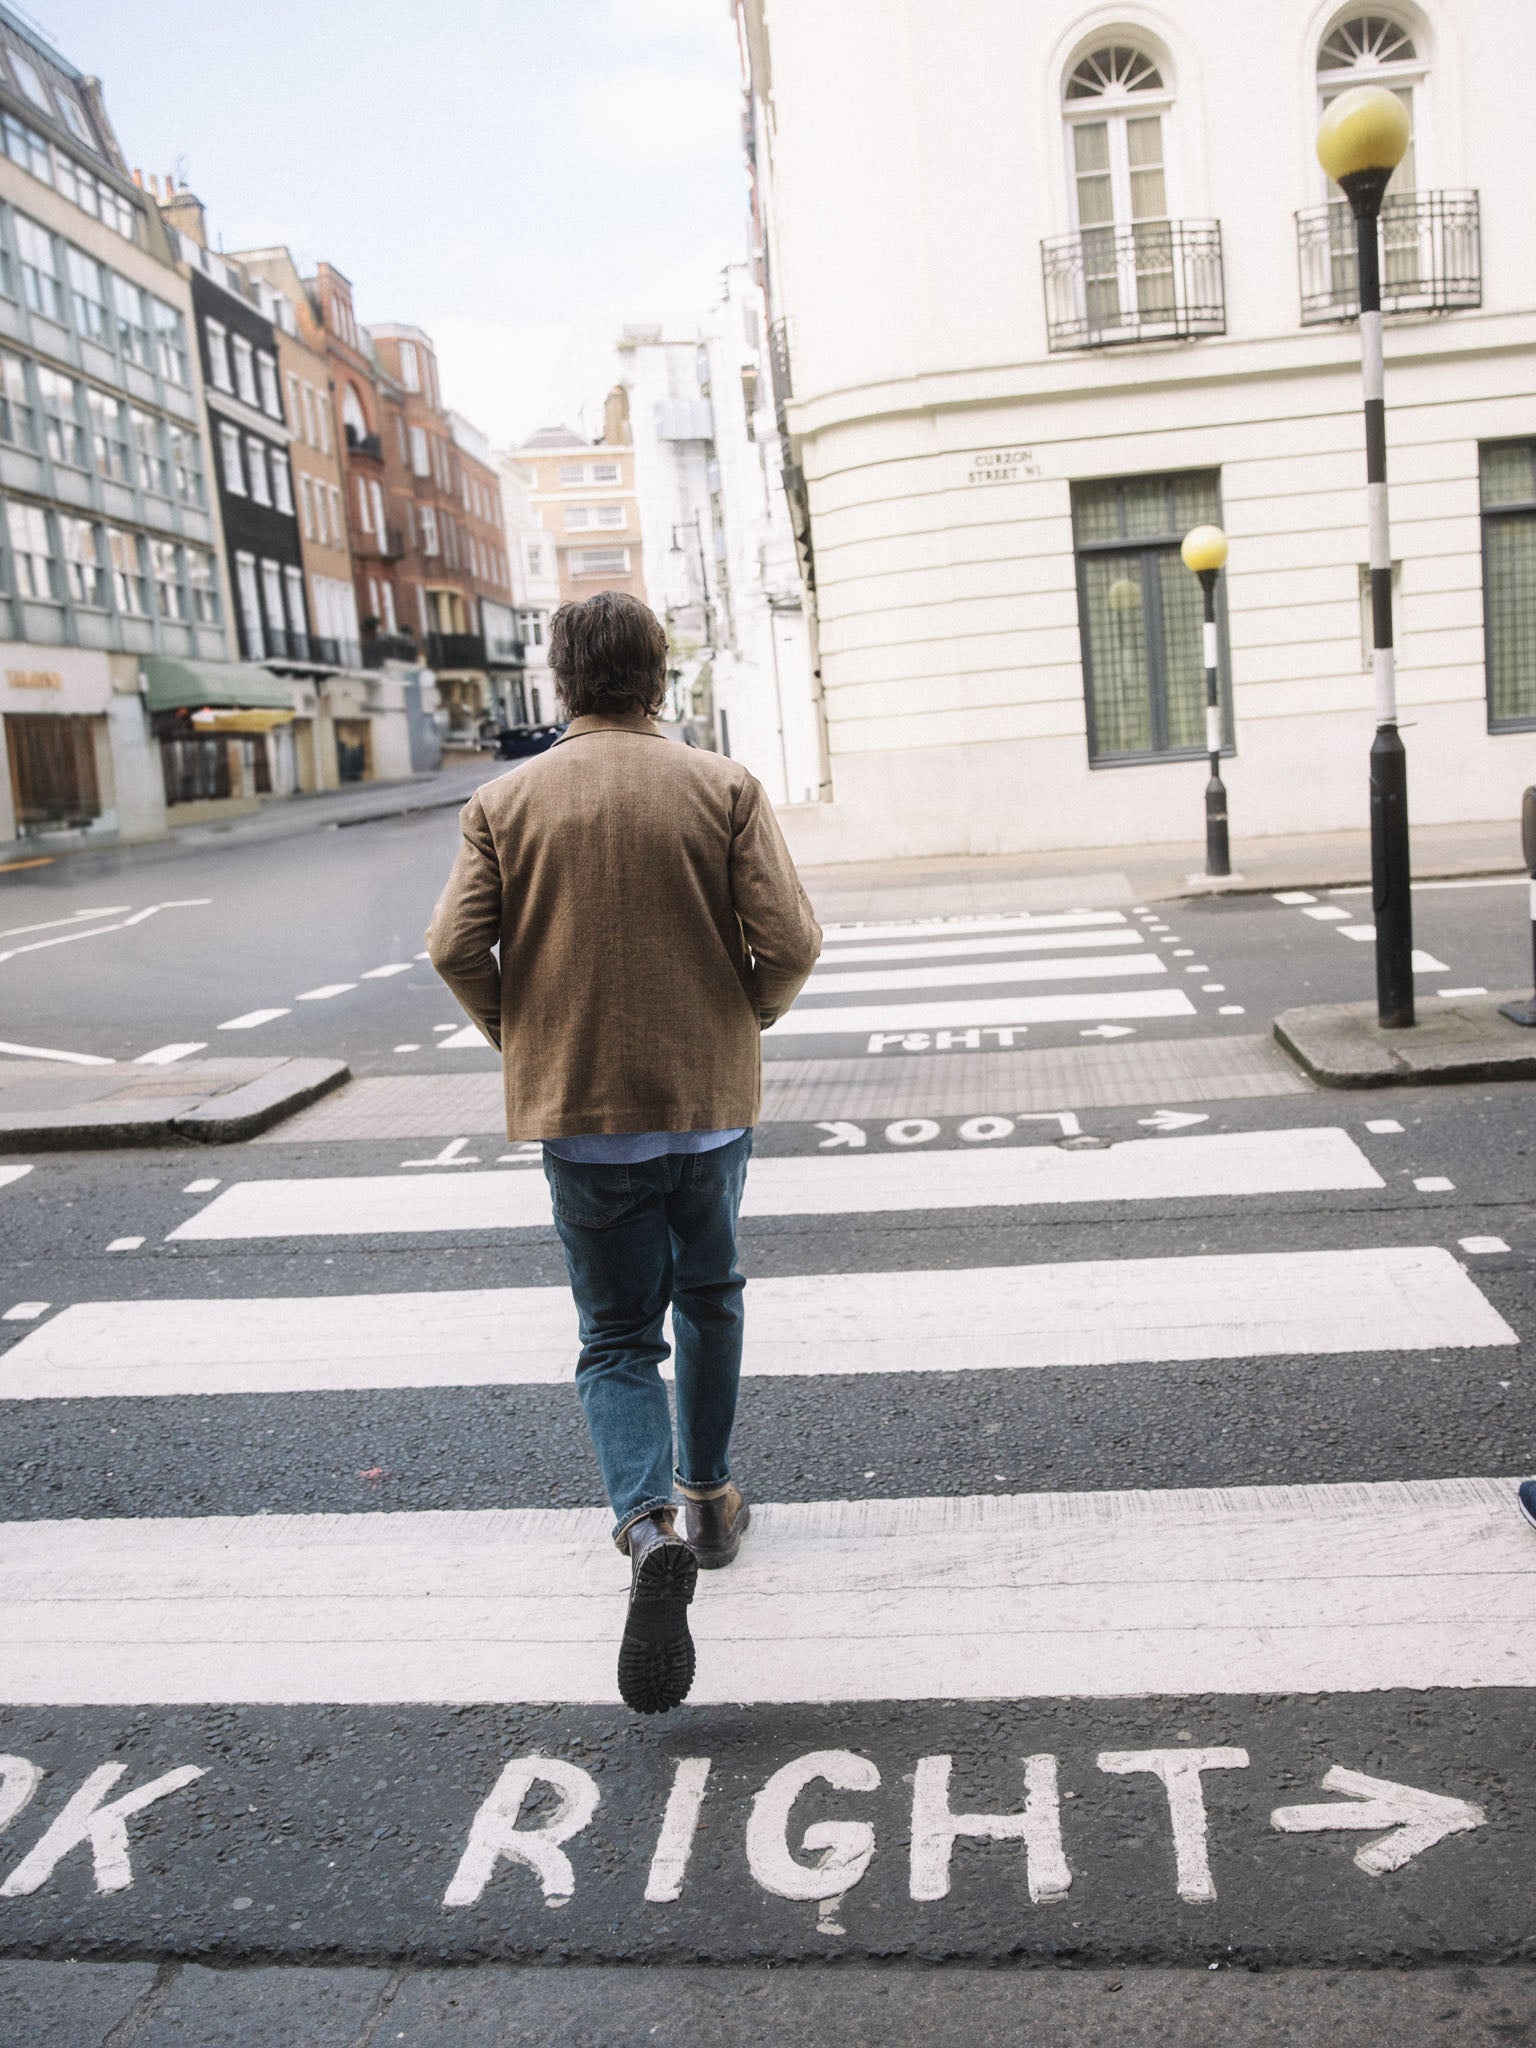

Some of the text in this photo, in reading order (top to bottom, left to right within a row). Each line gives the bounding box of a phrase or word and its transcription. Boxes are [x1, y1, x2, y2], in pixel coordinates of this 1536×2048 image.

[974, 450, 1033, 467] CURZON
[968, 467, 1018, 483] STREET
[813, 1112, 1086, 1149] LOOK
[442, 1748, 1252, 1909] RIGHT
